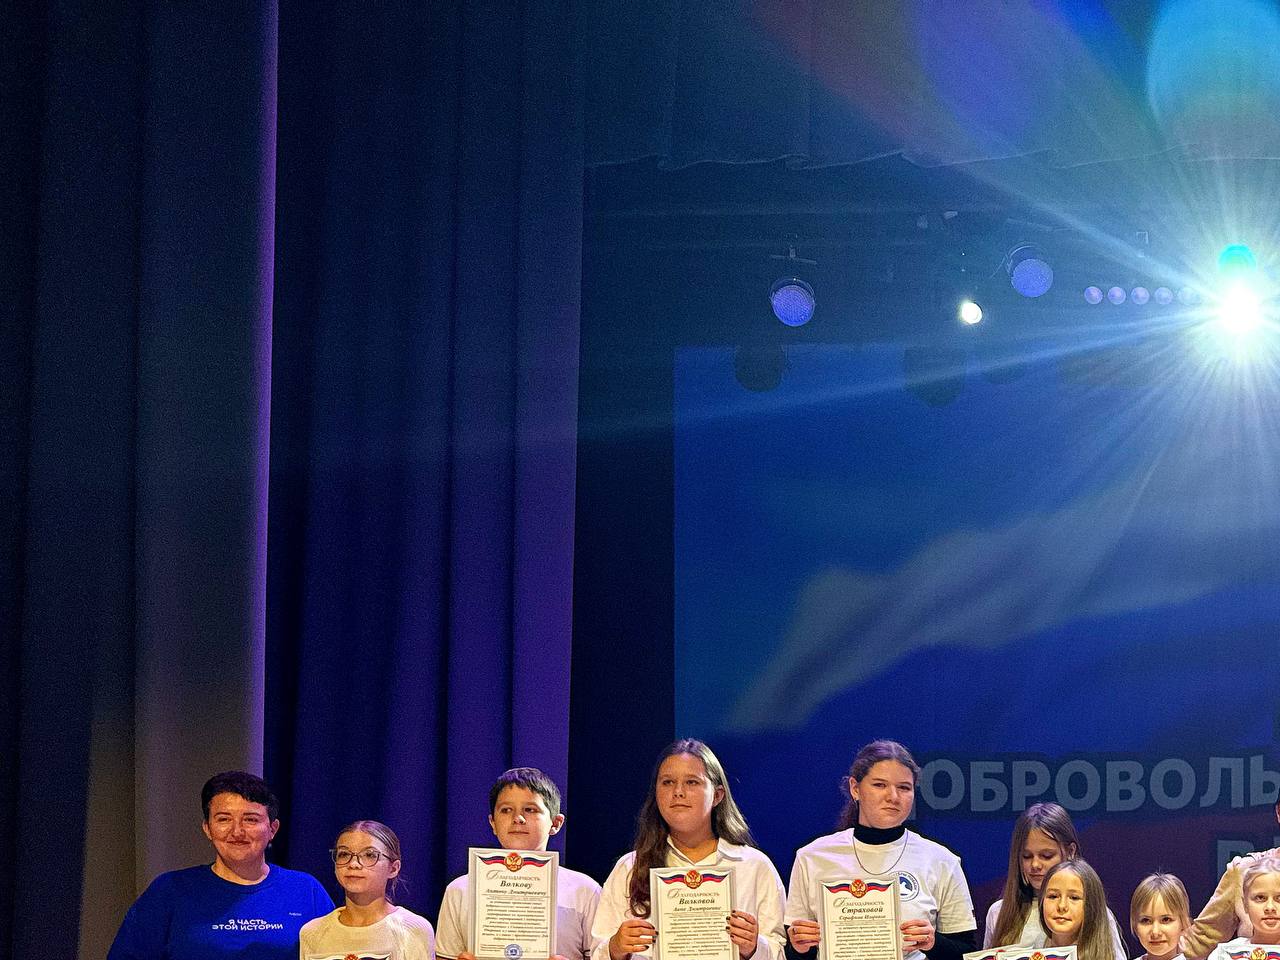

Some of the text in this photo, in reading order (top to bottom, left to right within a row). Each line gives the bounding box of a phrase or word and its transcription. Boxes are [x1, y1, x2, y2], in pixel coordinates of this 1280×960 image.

[500, 880, 532, 888] Волкову
[841, 906, 883, 914] Страховой
[240, 923, 284, 931] ИСТОРИИ
